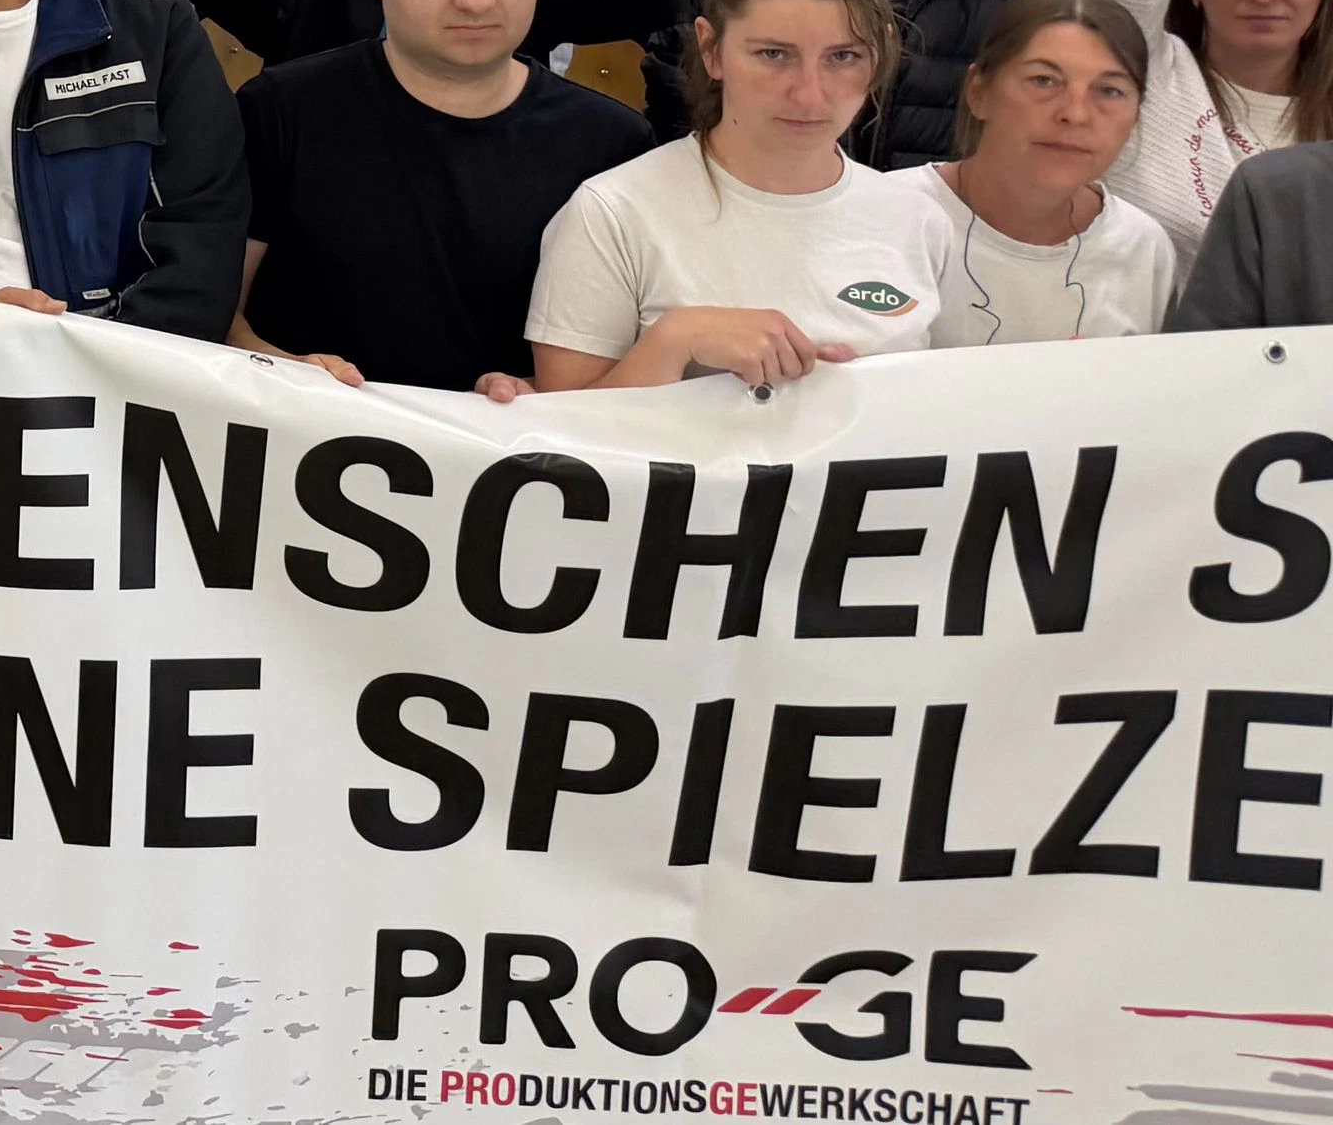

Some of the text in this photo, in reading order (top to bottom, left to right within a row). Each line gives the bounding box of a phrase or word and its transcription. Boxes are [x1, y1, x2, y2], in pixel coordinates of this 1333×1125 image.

[55, 69, 131, 96] MICHAEL FAST
[848, 287, 900, 306] ardo
[348, 673, 1333, 891] SPIELZE
[366, 1065, 1033, 1125] DIE PRODUKTIONSGEWERKSCHAFT
